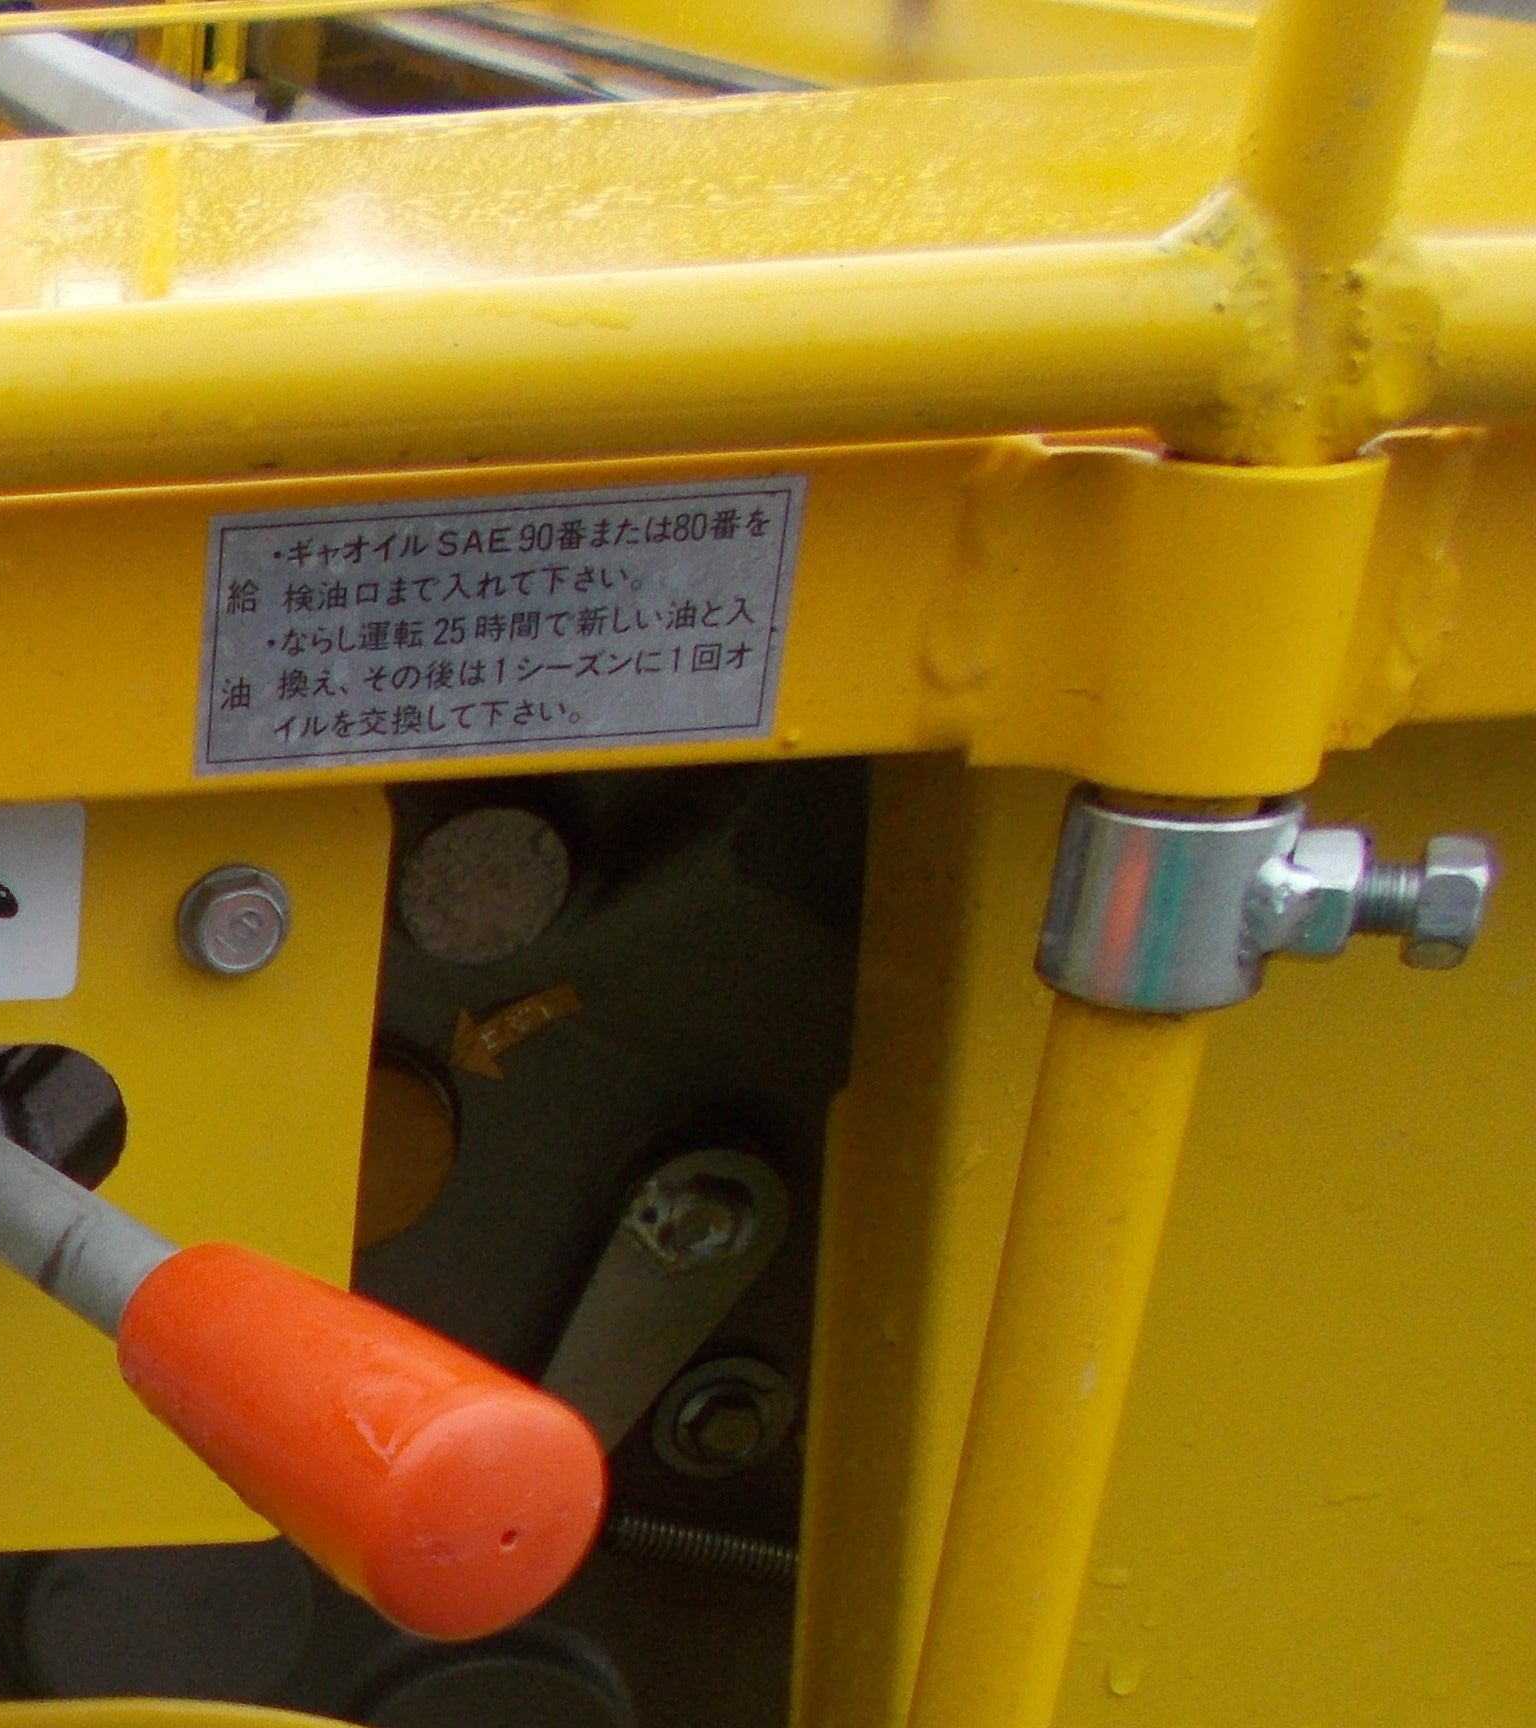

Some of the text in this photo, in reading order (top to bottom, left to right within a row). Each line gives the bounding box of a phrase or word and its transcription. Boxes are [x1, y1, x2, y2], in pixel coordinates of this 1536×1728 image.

[273, 699, 582, 738] イルを交換して下さい。
